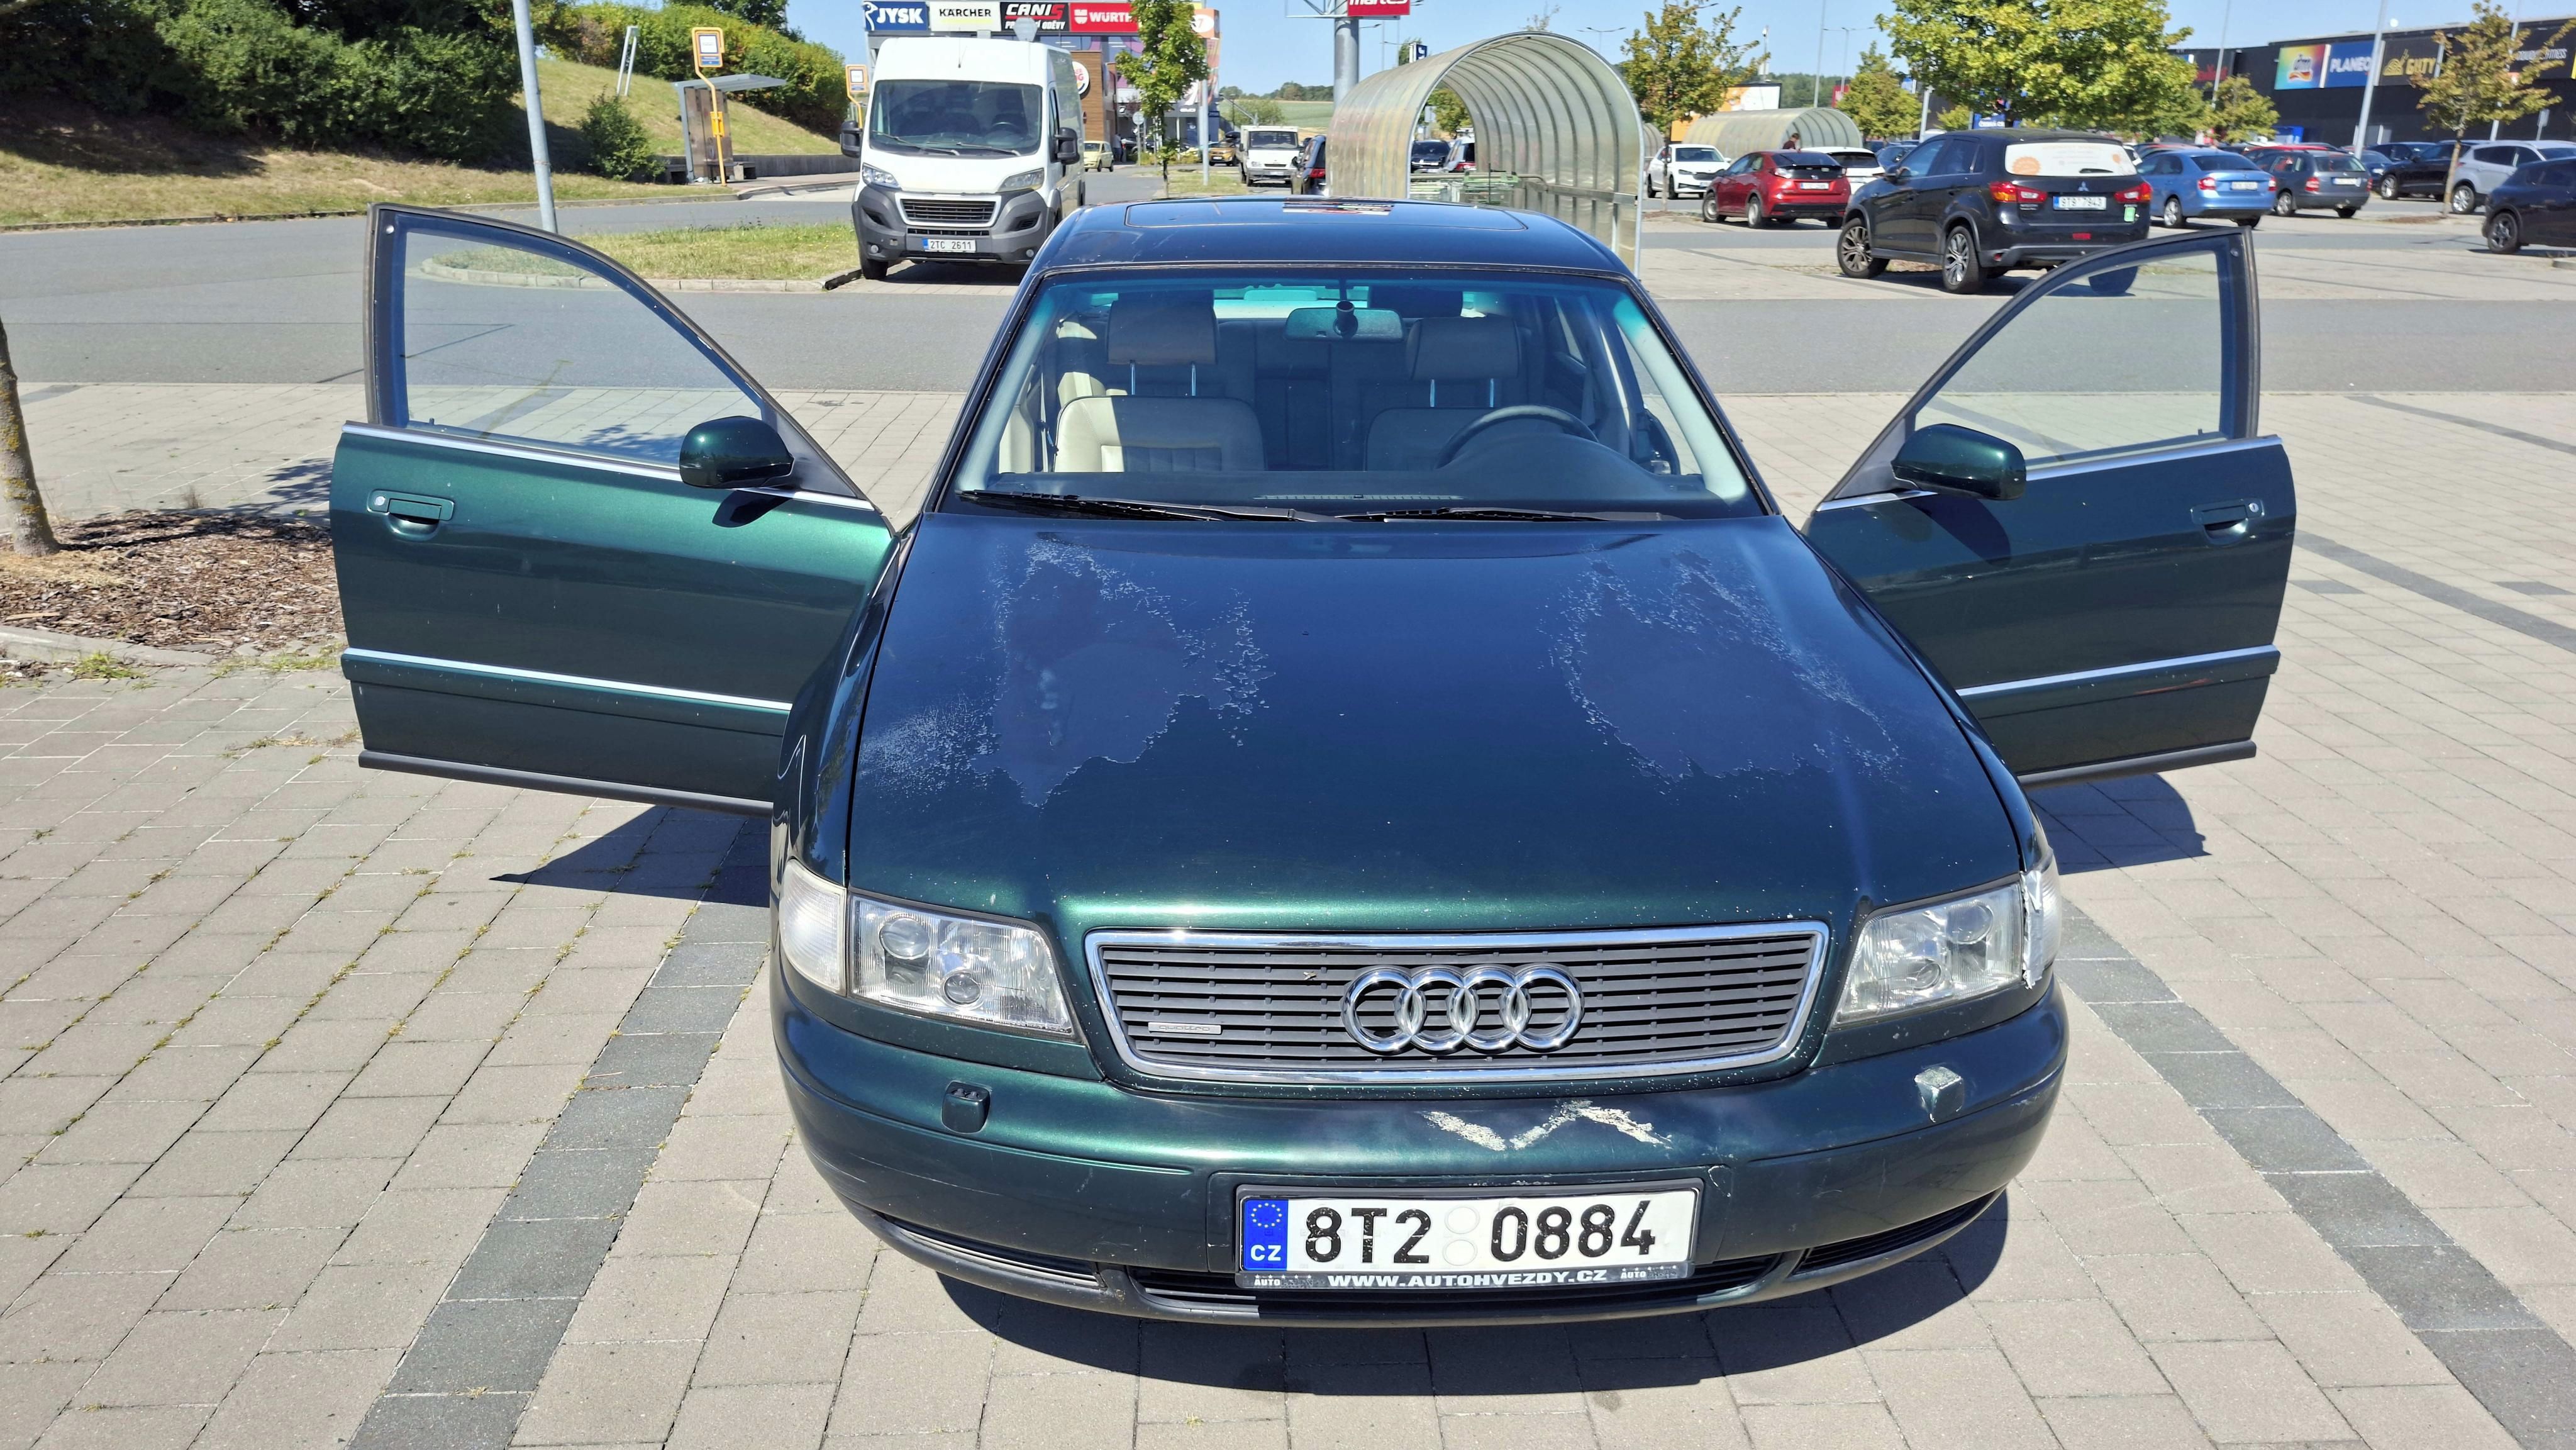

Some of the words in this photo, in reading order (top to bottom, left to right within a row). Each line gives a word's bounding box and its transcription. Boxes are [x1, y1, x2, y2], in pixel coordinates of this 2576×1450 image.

[876, 8, 924, 24] JYSK
[939, 8, 991, 17] KÄRCHER
[1006, 4, 1065, 19] CANIS
[2329, 56, 2372, 73] PLANEO
[931, 241, 945, 249] 2TC
[952, 242, 972, 250] 2611
[1250, 1244, 1281, 1261] CZ
[1305, 1206, 1431, 1263] 8T2
[1491, 1200, 1656, 1262] 0884
[1327, 1269, 1607, 1288] WWW.AUTOHVEZDY.CZ
[1620, 1271, 1646, 1279] AUTO
